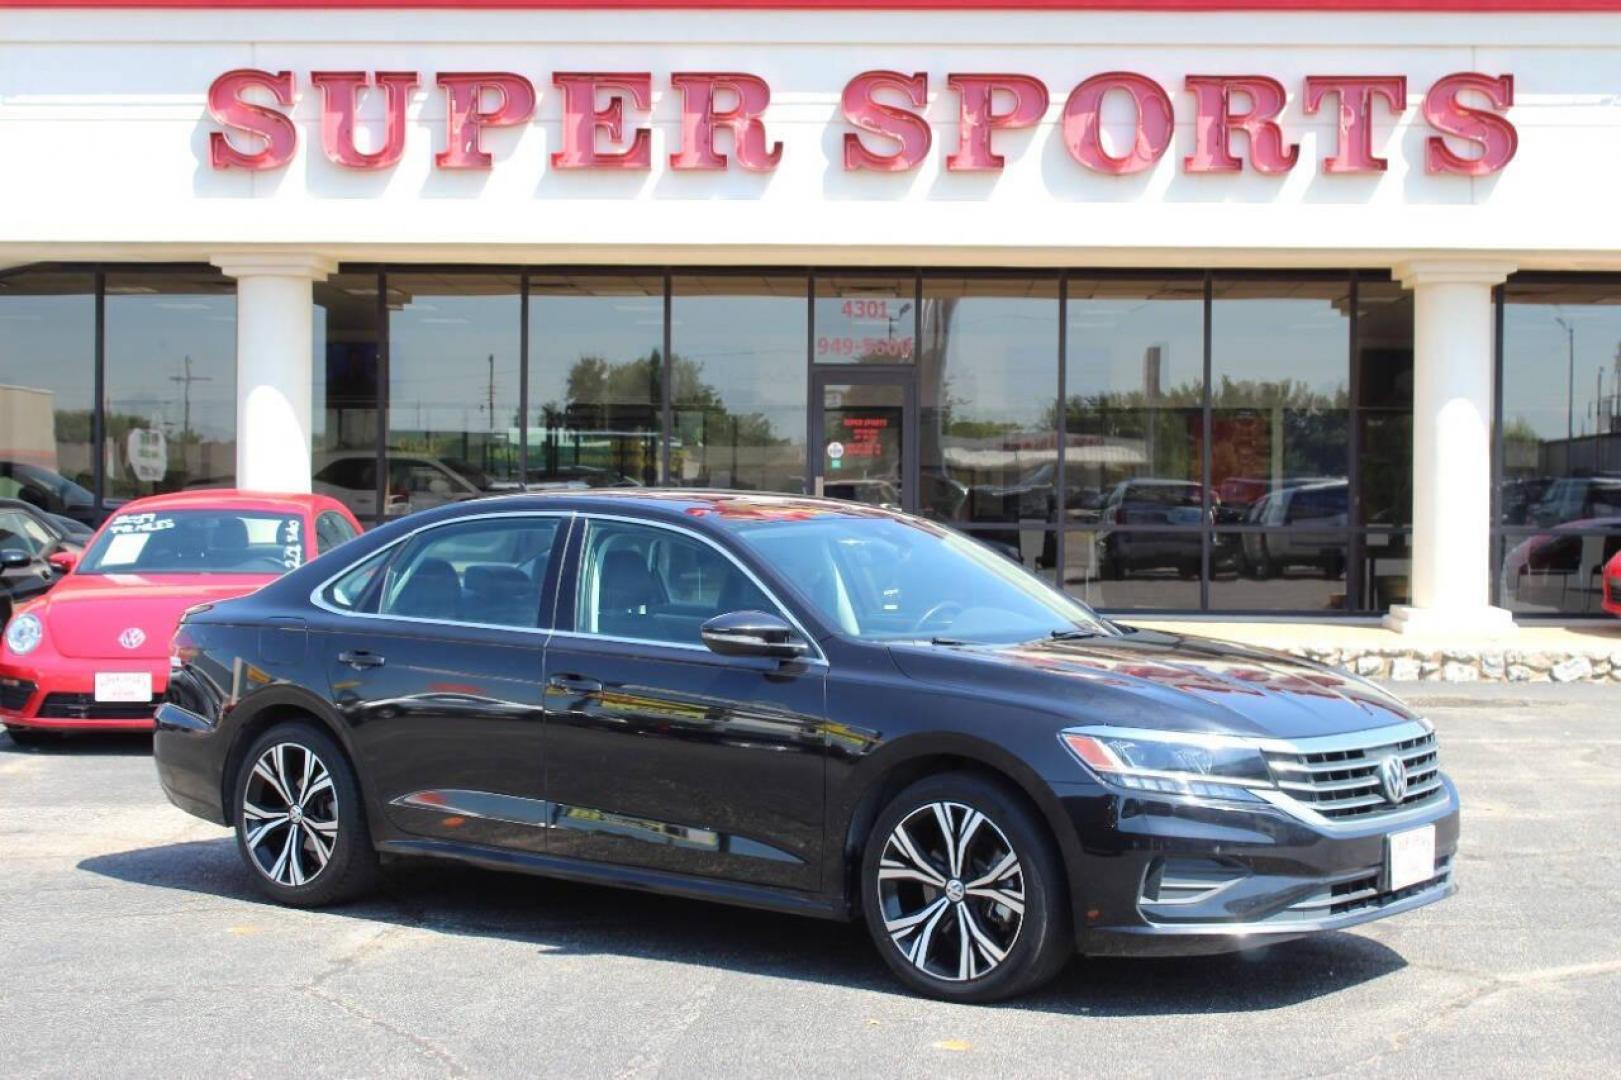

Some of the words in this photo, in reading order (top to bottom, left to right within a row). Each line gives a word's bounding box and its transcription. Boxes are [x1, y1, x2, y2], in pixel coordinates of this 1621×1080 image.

[207, 69, 784, 172] SUPER
[841, 69, 1519, 176] SPORTS
[841, 300, 888, 319] 4301
